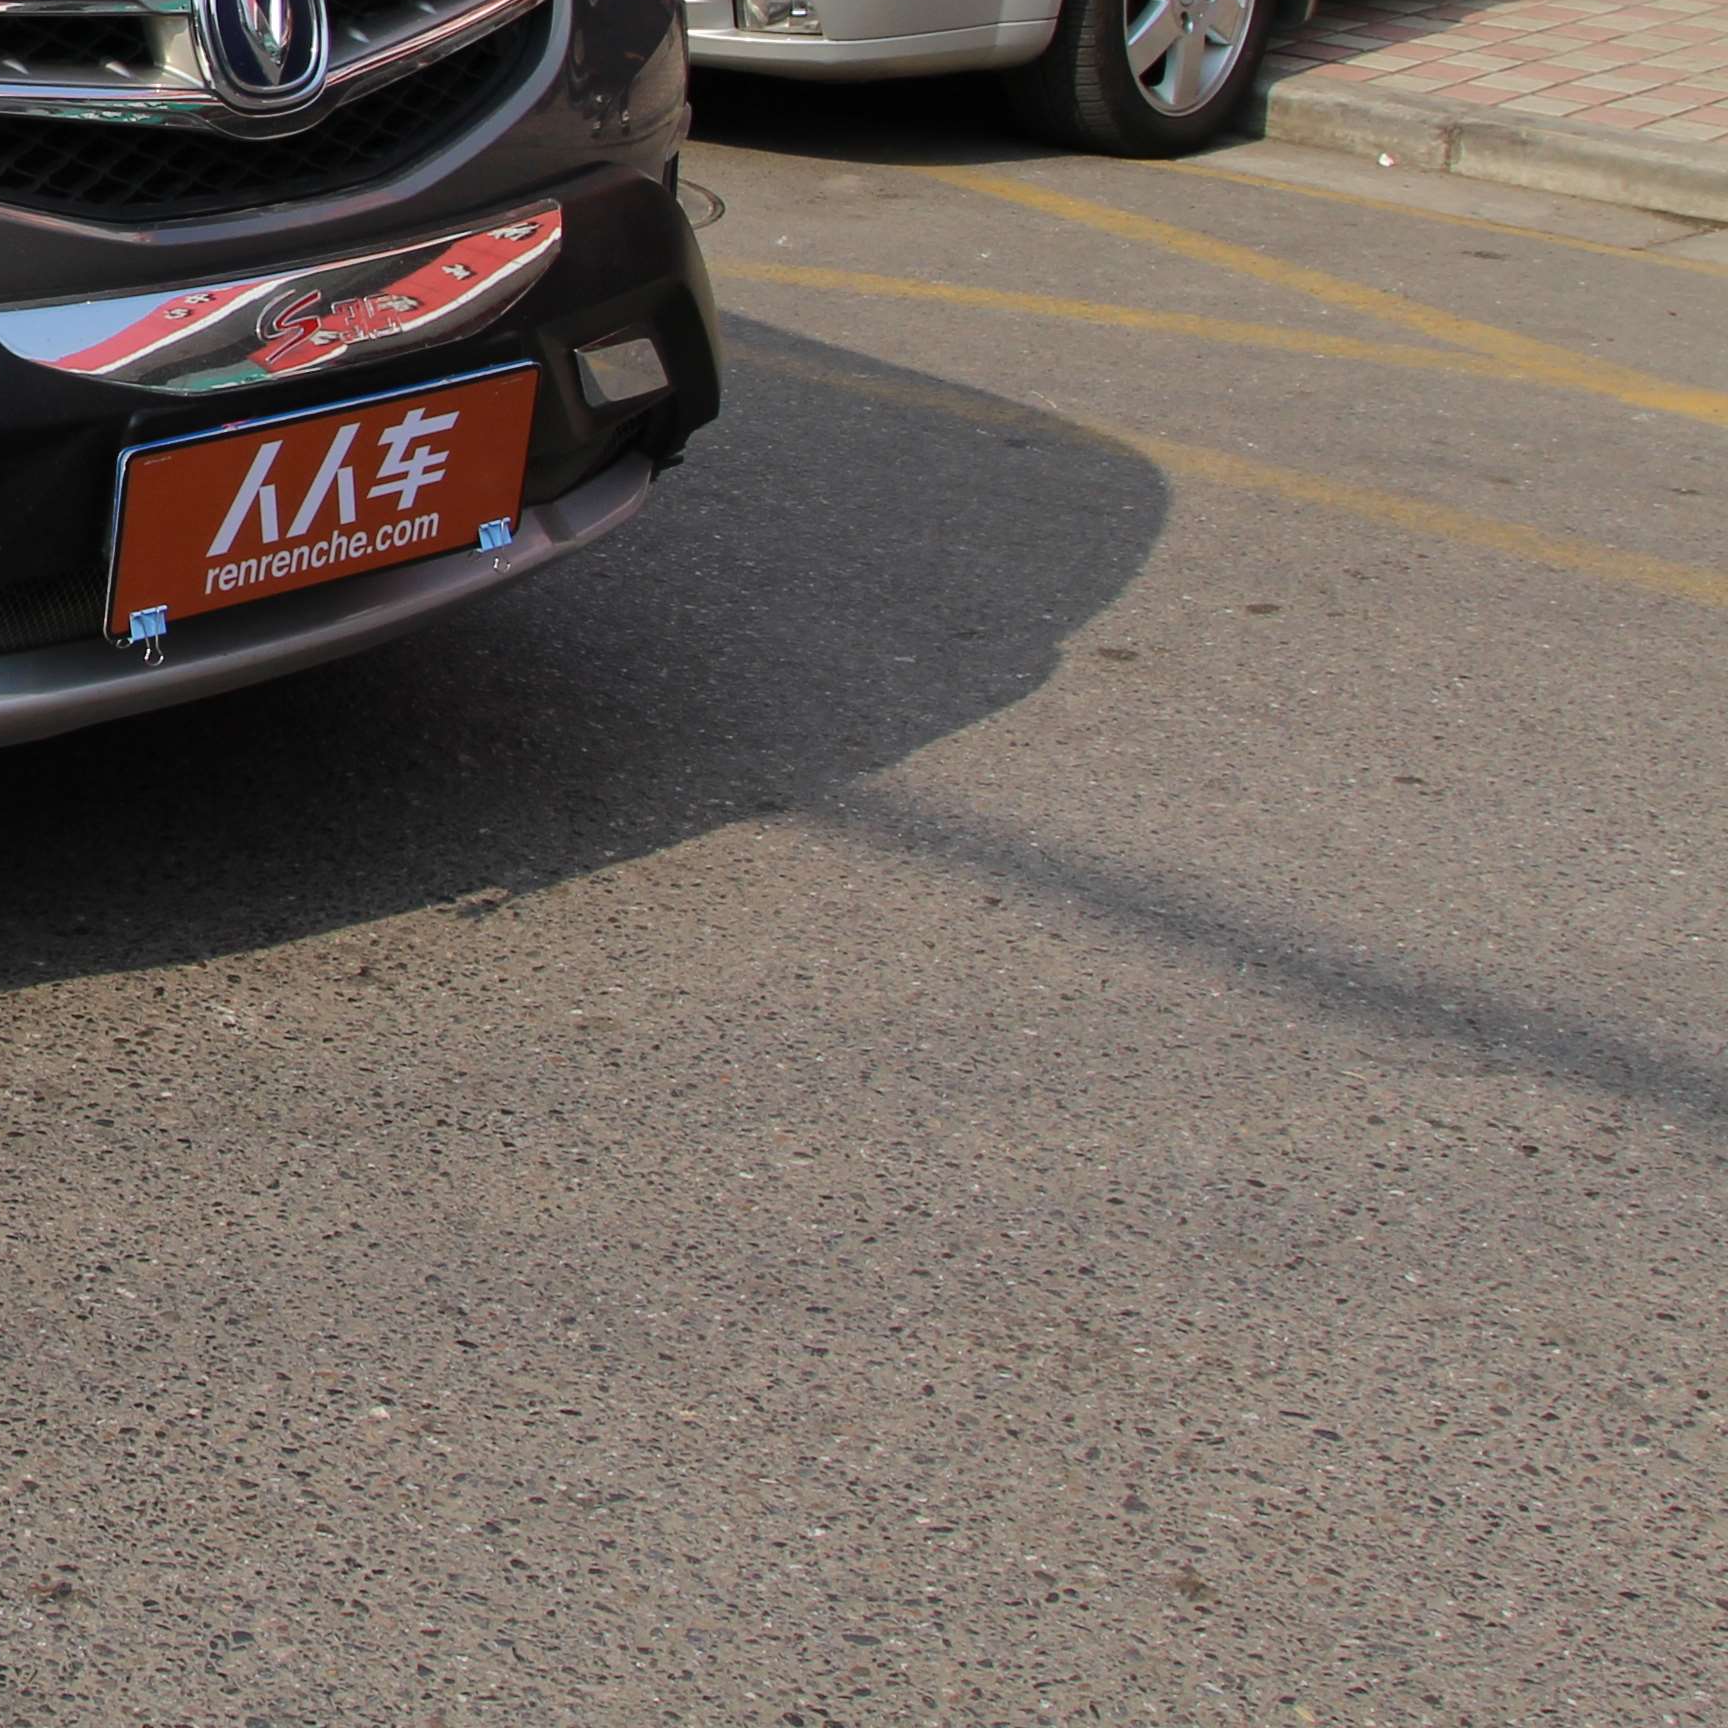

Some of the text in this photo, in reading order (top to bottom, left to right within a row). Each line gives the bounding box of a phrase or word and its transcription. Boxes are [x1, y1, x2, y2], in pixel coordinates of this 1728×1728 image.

[206, 407, 460, 558] 人人车
[204, 508, 441, 596] renrenche.com
